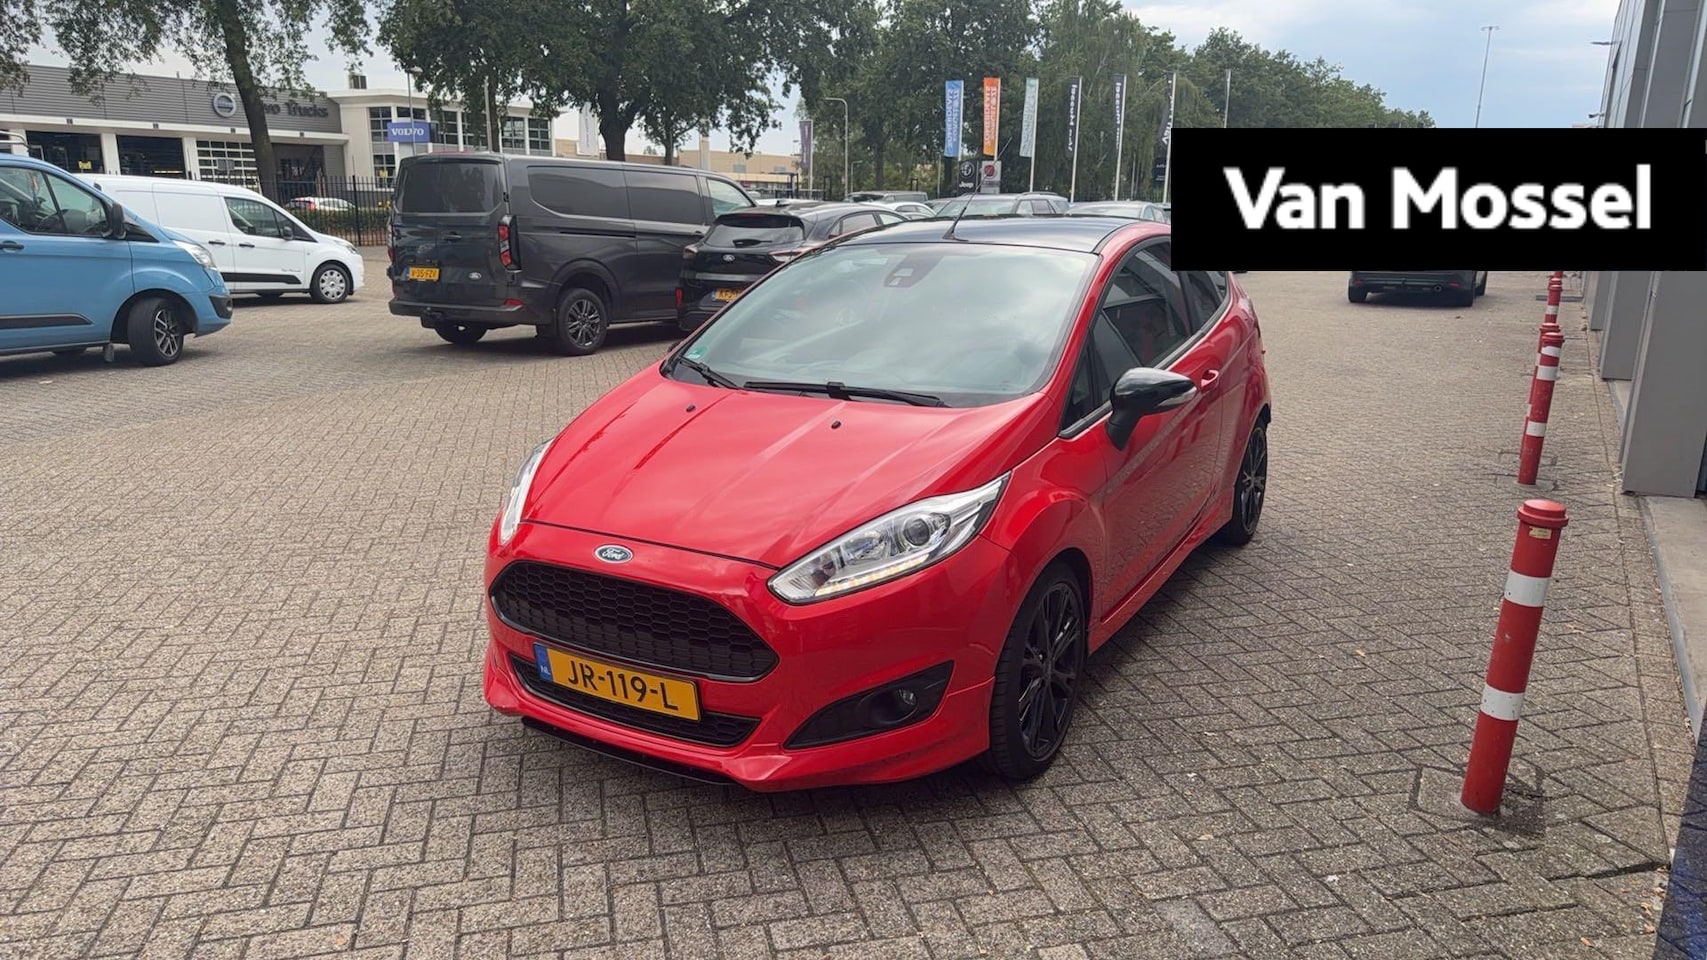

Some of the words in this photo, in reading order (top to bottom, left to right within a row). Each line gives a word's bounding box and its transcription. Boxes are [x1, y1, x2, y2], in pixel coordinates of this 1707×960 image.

[285, 99, 329, 118] Trucks
[391, 127, 425, 136] VOLVO
[600, 547, 628, 561] Ford
[567, 660, 679, 711] JR-119-L
